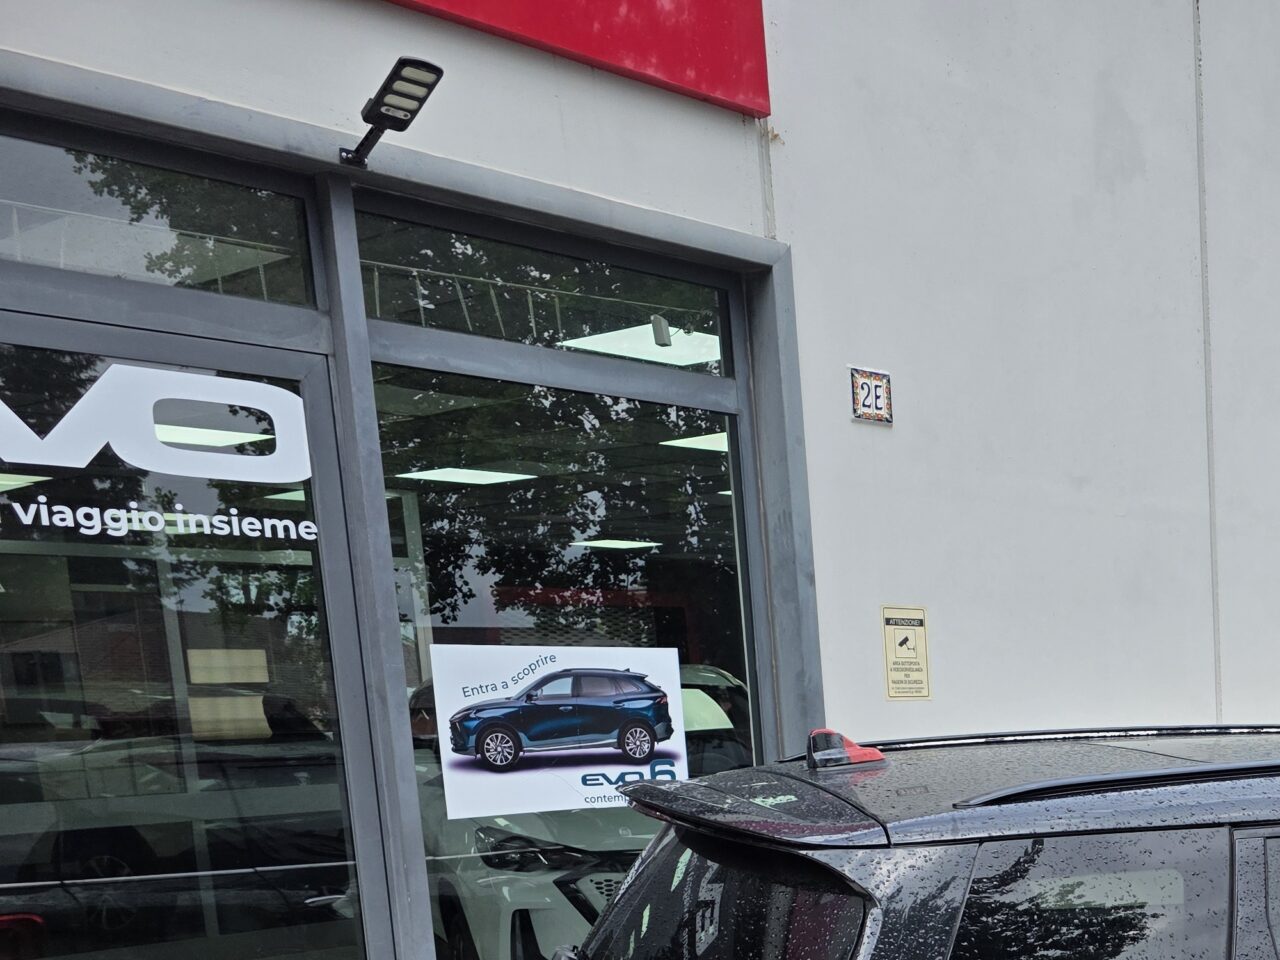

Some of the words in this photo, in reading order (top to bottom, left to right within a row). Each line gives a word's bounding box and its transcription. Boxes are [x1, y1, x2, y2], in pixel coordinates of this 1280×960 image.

[860, 381, 883, 410] 2E
[12, 495, 166, 536] viaggio
[174, 503, 318, 541] insieme
[462, 681, 498, 698] Entra
[501, 680, 509, 690] a
[511, 653, 557, 685] scoprire
